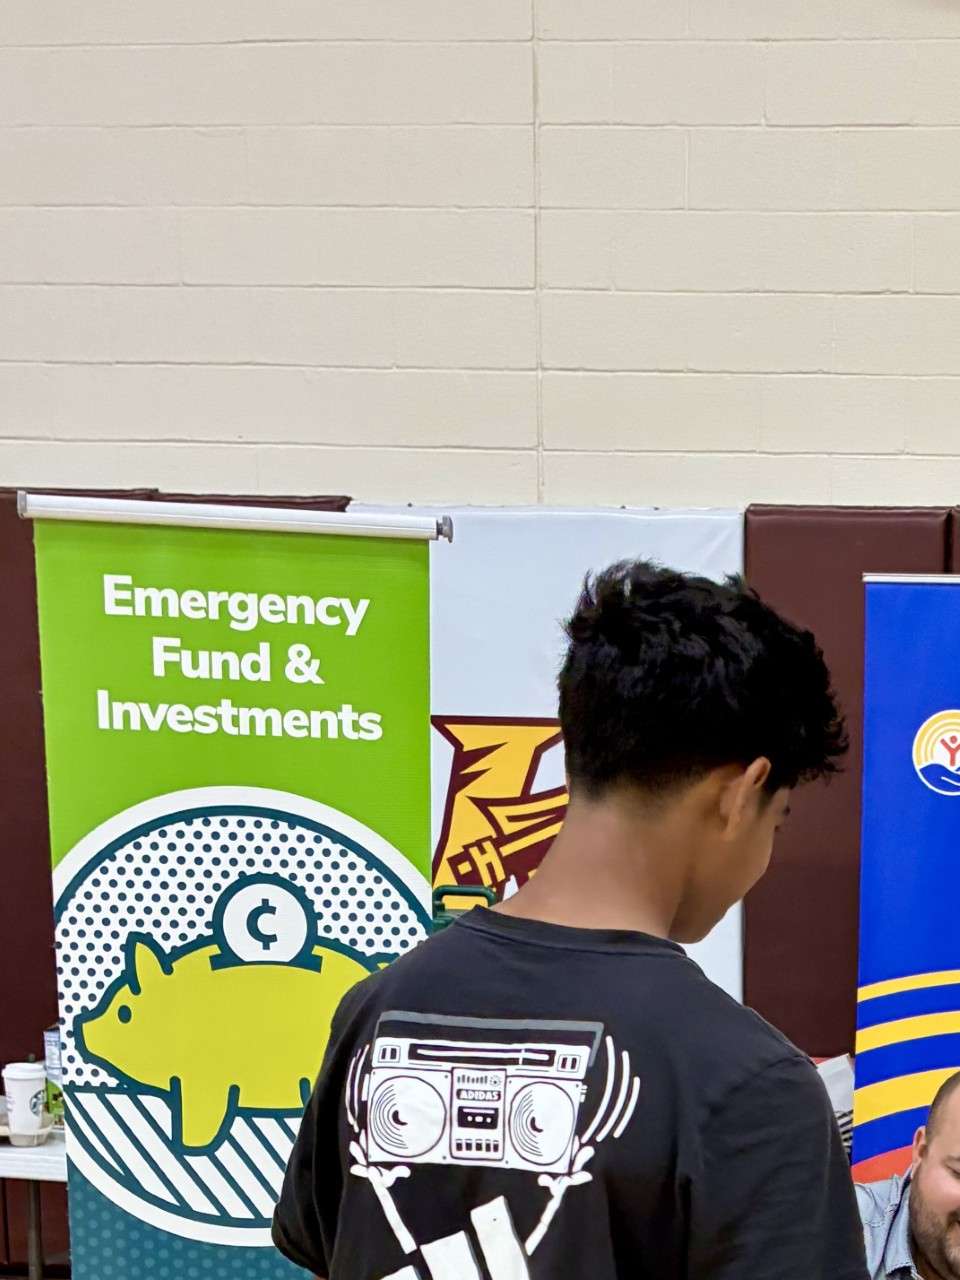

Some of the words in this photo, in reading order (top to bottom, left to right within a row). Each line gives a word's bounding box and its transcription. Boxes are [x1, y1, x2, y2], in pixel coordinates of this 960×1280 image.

[103, 573, 370, 636] Emergency
[152, 636, 271, 682] Fund
[284, 643, 326, 685] &
[96, 689, 384, 742] Investments
[460, 1088, 499, 1101] ADIDAS
